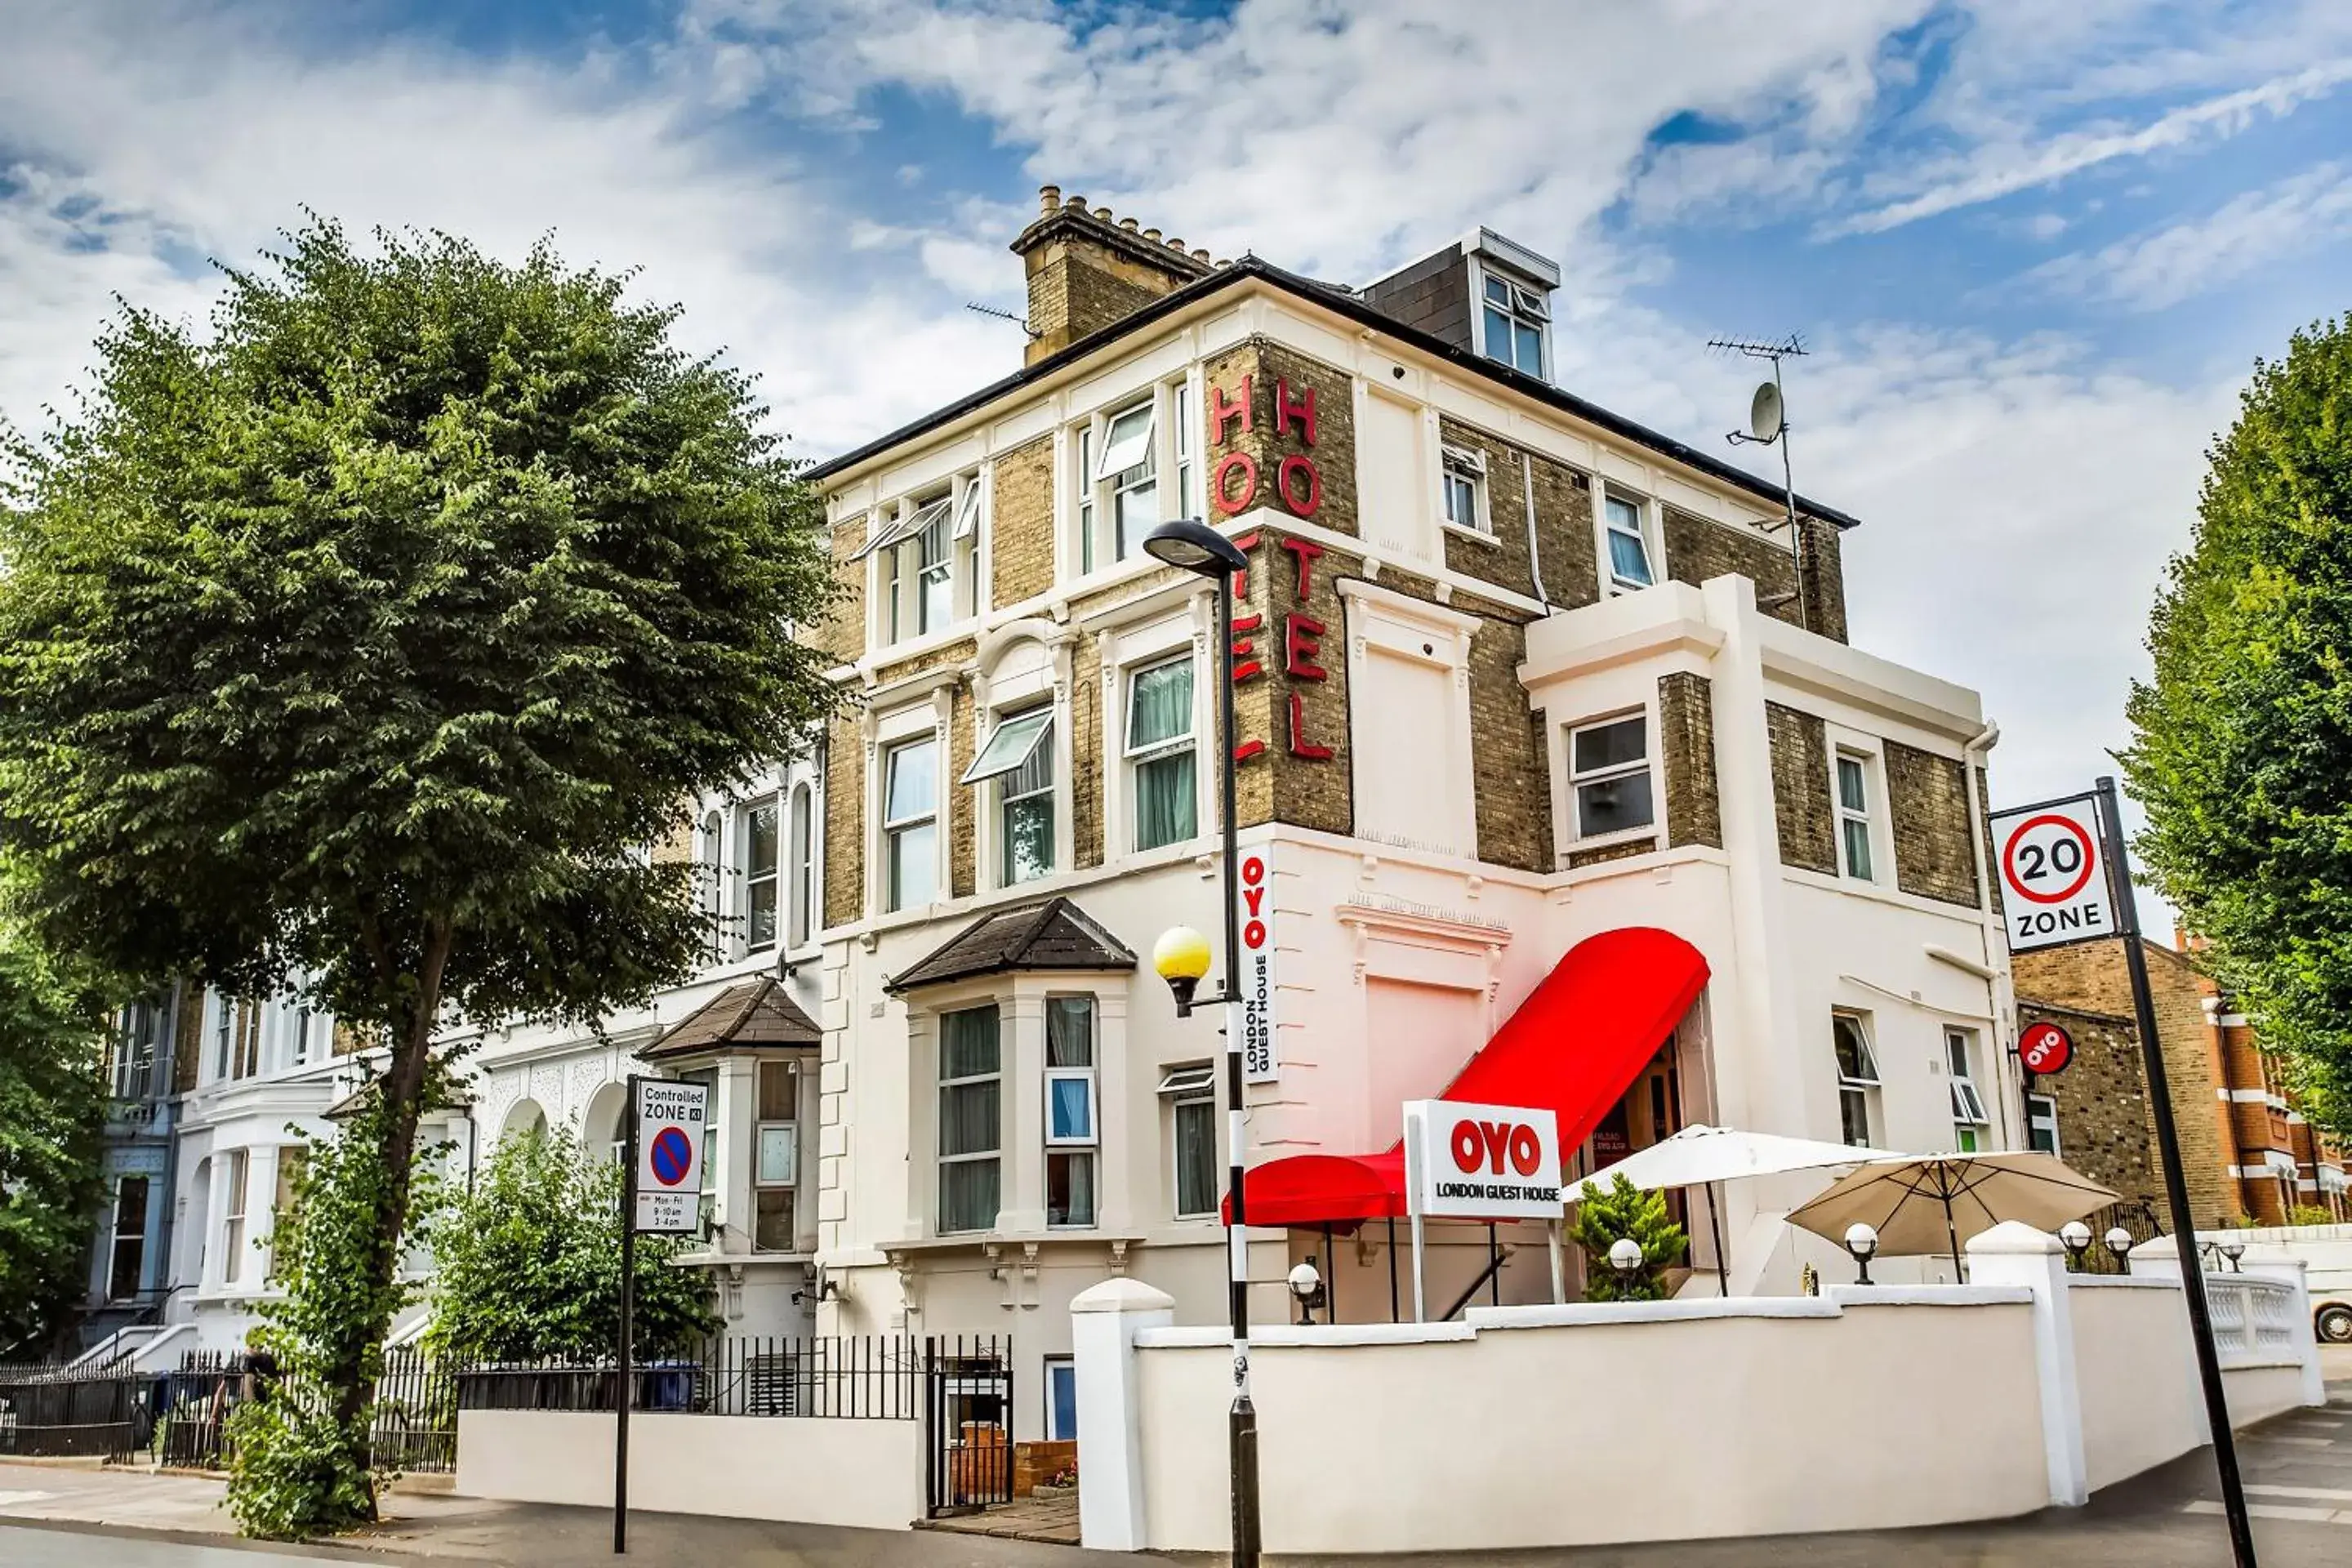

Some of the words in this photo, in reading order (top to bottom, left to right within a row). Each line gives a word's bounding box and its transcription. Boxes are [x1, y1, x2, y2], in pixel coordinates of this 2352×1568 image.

[1276, 374, 1334, 761] HOTEL
[2018, 837, 2082, 881] 20
[1242, 856, 1267, 951] OYO
[2017, 902, 2102, 938] ZONE
[1255, 954, 1267, 1016] HOUSE
[1245, 1000, 1258, 1074] LONDON
[1258, 1018, 1270, 1072] GUEST
[2026, 1031, 2060, 1066] OYO
[644, 1102, 686, 1120] ZONE
[645, 1087, 704, 1103] Controlled
[1450, 1118, 1542, 1177] OYO
[1436, 1182, 1485, 1198] LONDON
[1486, 1184, 1521, 1200] GUEST
[1522, 1187, 1561, 1202] HOUSE
